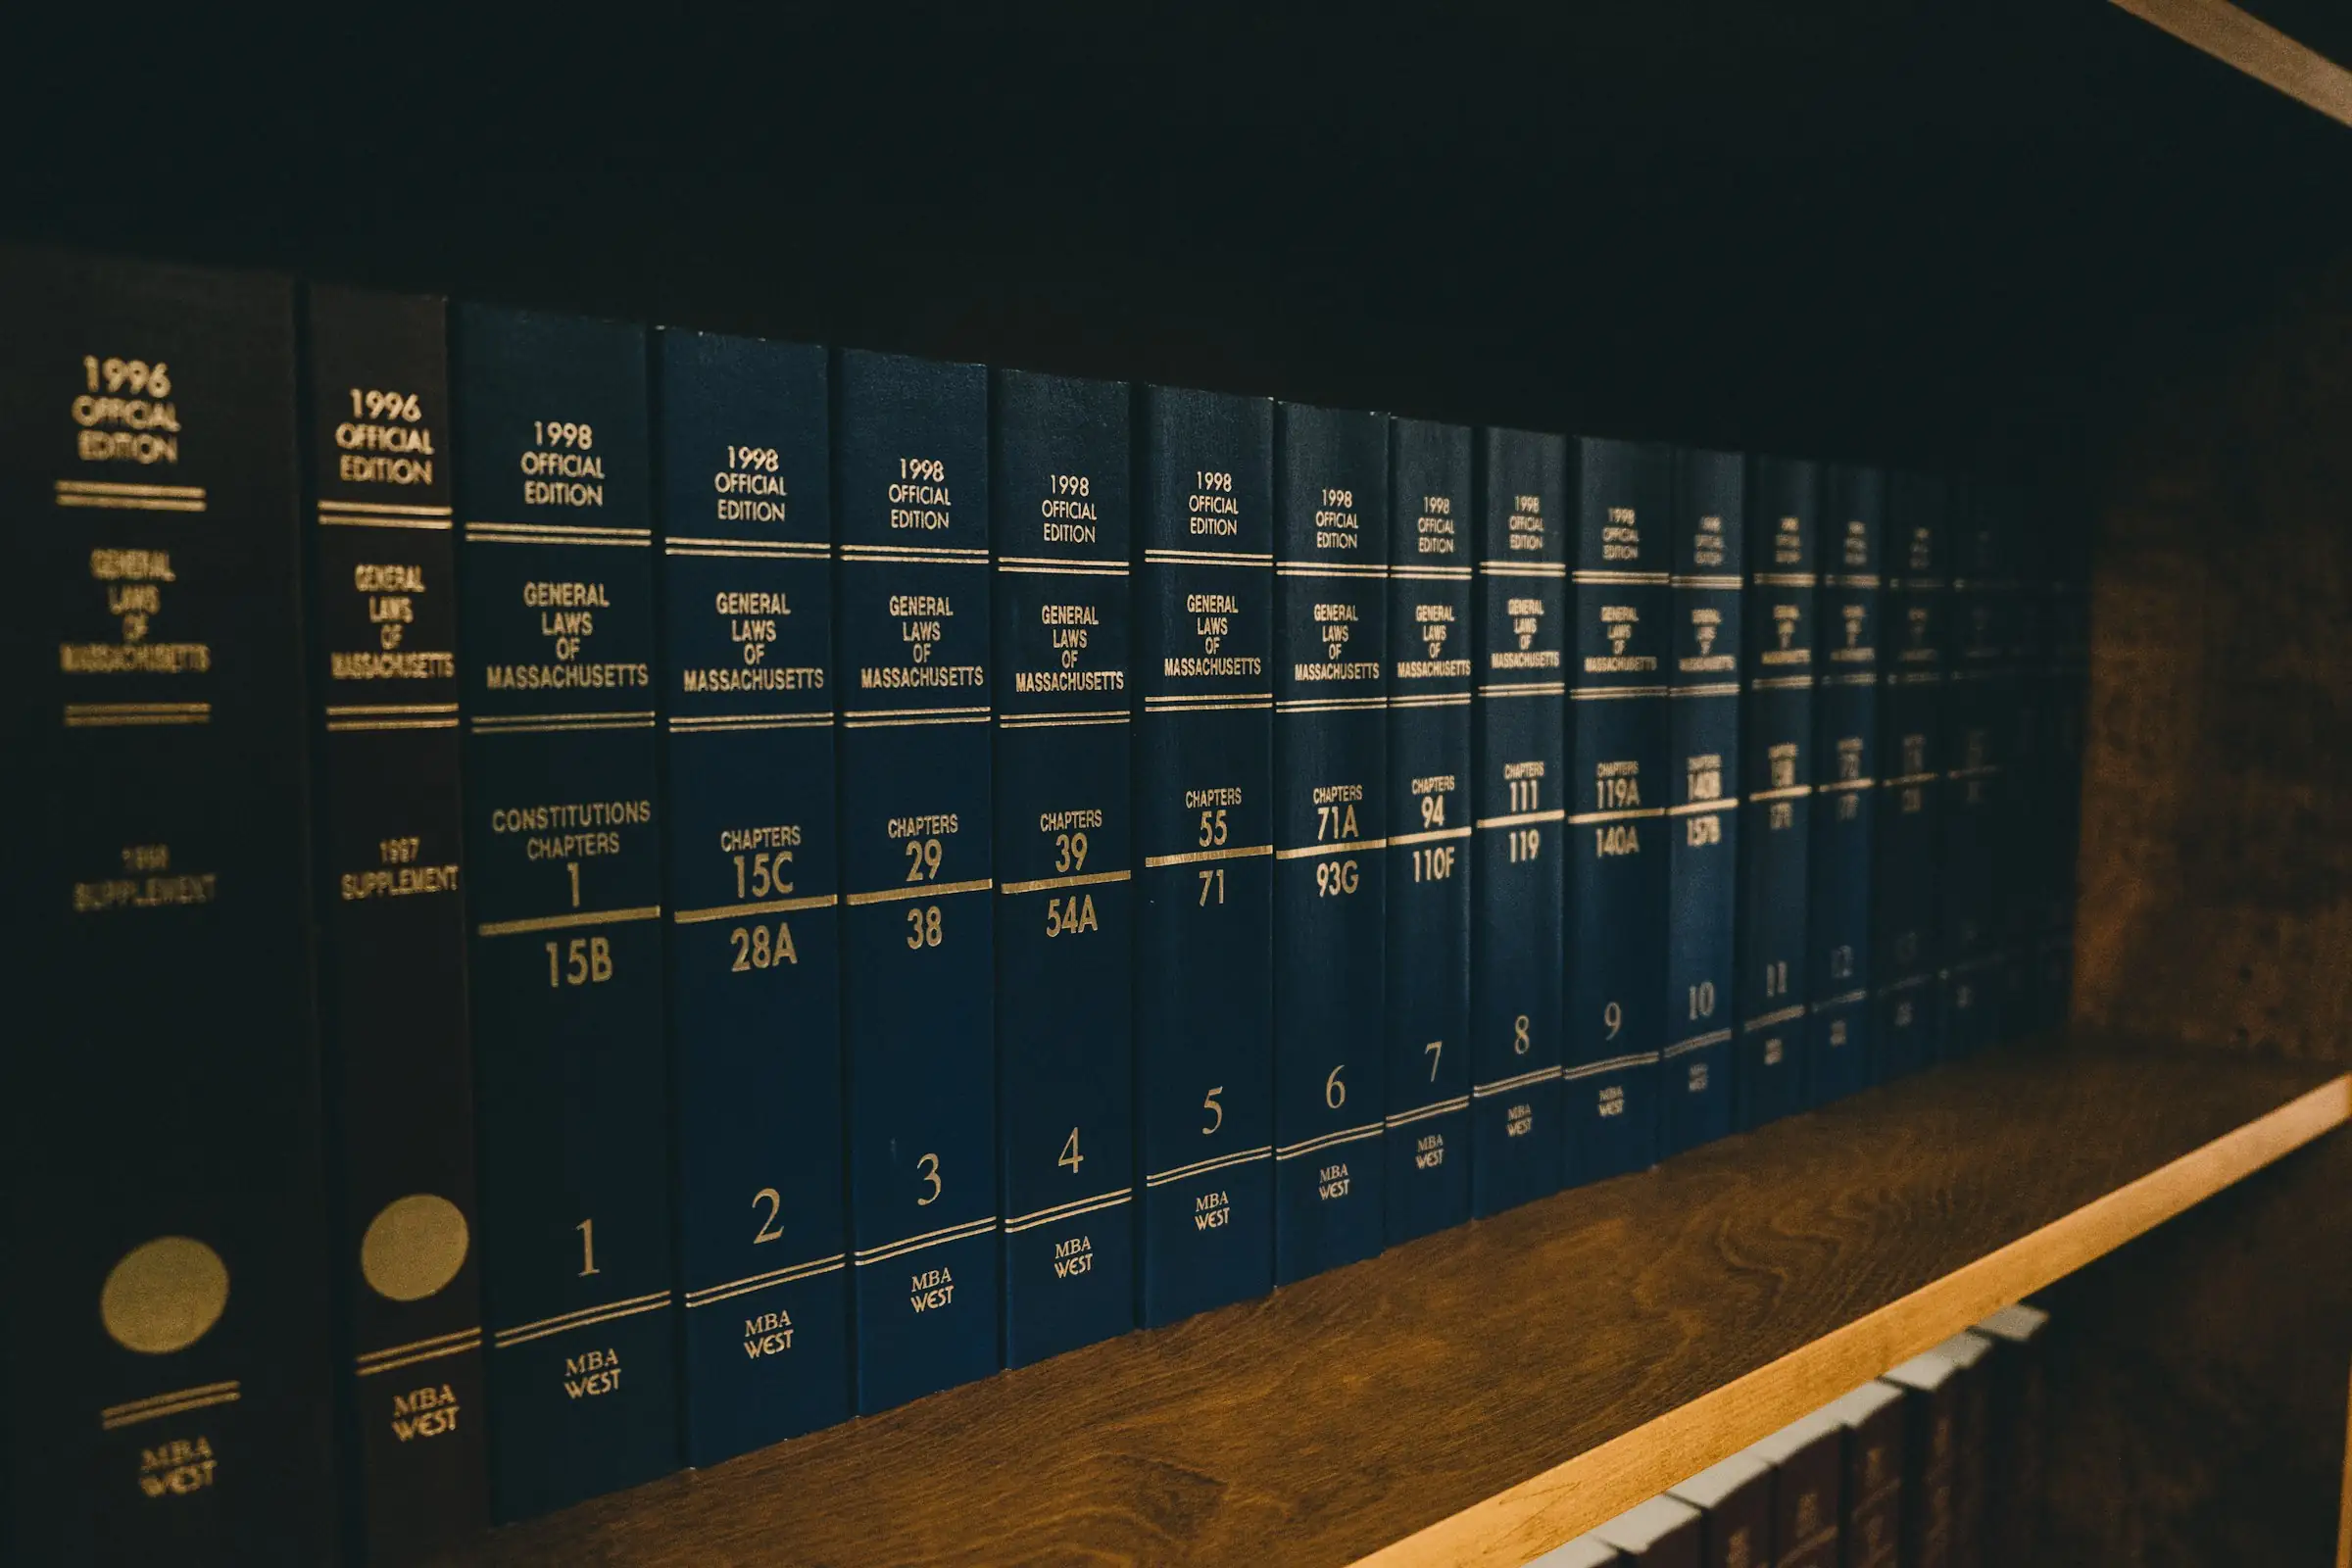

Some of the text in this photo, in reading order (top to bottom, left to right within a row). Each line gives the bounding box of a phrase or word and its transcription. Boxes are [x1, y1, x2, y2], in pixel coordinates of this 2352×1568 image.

[351, 389, 421, 422] 1996
[335, 423, 434, 455] OFFICIAL
[535, 421, 592, 450] 1998
[340, 455, 432, 484] EDITION
[520, 451, 605, 478] OFFICIAL
[728, 446, 779, 472] 1998
[901, 459, 944, 482] 1998
[714, 472, 787, 496] OFFICIAL
[1051, 474, 1089, 497] 1998
[1198, 471, 1232, 492] 1998
[524, 480, 603, 507] EDITION
[889, 484, 951, 506] OFFICIAL
[1189, 495, 1239, 514] OFFICIAL
[1322, 489, 1352, 508] 1998
[1515, 496, 1540, 514] 1998
[717, 499, 785, 521] EDITION
[1042, 500, 1097, 520] OFFICIAL
[1424, 497, 1449, 514] 1998
[891, 509, 949, 529] EDITION
[1191, 517, 1237, 535] EDITION
[1315, 511, 1358, 528] OFFICIAL
[1418, 517, 1454, 534] OFFICIAL
[1509, 515, 1544, 532] OFFICIAL
[1044, 523, 1095, 543] EDITION
[1317, 531, 1357, 549] EDITION
[1509, 533, 1543, 550] EDITION
[1418, 537, 1453, 554] EDITION
[355, 564, 425, 592] GENERAL
[523, 581, 610, 608] GENERAL
[716, 592, 791, 614] GENERAL
[890, 596, 954, 616] GENERAL
[1187, 594, 1239, 612] GENERAL
[369, 596, 413, 623] LAWS
[1042, 605, 1099, 625] GENERAL
[1314, 604, 1358, 621] GENERAL
[1415, 605, 1454, 622] GENERAL
[1508, 599, 1544, 615] GENERAL
[542, 612, 593, 635] LAWS
[732, 619, 776, 642] LAWS
[903, 621, 941, 641] LAWS
[1198, 617, 1228, 635] LAWS
[1323, 625, 1348, 642] LAWS
[1423, 625, 1446, 642] LAWS
[1514, 617, 1537, 634] LAWS
[381, 623, 403, 650] OF
[1054, 629, 1087, 648] LAWS
[1205, 637, 1220, 655] OF
[1519, 634, 1531, 650] OF
[556, 636, 580, 661] OF
[744, 643, 764, 665] OF
[913, 643, 931, 663] OF
[1062, 650, 1078, 668] OF
[1329, 643, 1342, 660] OF
[1429, 642, 1441, 659] OF
[1491, 651, 1560, 668] MASSACHUSETTS
[331, 652, 454, 679] MASSACHUSETTS
[487, 663, 649, 690] MASSACHUSETTS
[861, 665, 983, 688] MASSACHUSETTS
[1164, 658, 1261, 676] MASSACHUSETTS
[1295, 662, 1379, 681] MASSACHUSETTS
[1397, 660, 1471, 678] MASSACHUSETTS
[684, 668, 823, 692] MASSACHUSETTS
[1016, 671, 1123, 692] MASSACHUSETTS
[1504, 761, 1544, 781] CHAPTERS
[1313, 784, 1362, 805] CHAPTERS
[1411, 775, 1454, 795] CHAPTERS
[1509, 780, 1539, 812] 111
[1596, 778, 1640, 809] 119A
[1186, 787, 1242, 808] CHAPTERS
[493, 800, 651, 832] CONSTITUTIONS
[1040, 809, 1102, 832] CHAPTERS
[1317, 805, 1358, 841] 71A
[1421, 795, 1445, 828] 94
[888, 813, 957, 838] CHAPTERS
[1200, 809, 1227, 847] 55
[527, 832, 619, 860] CHAPTERS
[721, 825, 801, 852] CHAPTERS
[1509, 829, 1540, 862] 119
[1595, 825, 1639, 858] 140A
[906, 839, 942, 881] 29
[1055, 832, 1087, 872] 39
[734, 851, 793, 898] 15C
[1413, 847, 1454, 882] 110F
[342, 864, 459, 900] SUPPLEMENT
[567, 862, 580, 907] 1
[1200, 869, 1224, 906] 71
[1316, 860, 1358, 898] 93G
[1047, 895, 1098, 937] 54A
[907, 906, 942, 950] 38
[730, 922, 798, 972] 28A
[546, 937, 612, 988] 15B
[1690, 982, 1715, 1020] 10
[1604, 1003, 1621, 1040] 9
[1515, 1015, 1529, 1054] 8
[1425, 1041, 1443, 1082] 7
[1326, 1065, 1346, 1108] 6
[1202, 1086, 1223, 1134] 5
[1508, 1104, 1531, 1123] MBA
[1506, 1117, 1532, 1137] WEST
[1058, 1127, 1084, 1173] 4
[1418, 1135, 1443, 1152] MBA
[1415, 1149, 1444, 1168] WEST
[917, 1153, 941, 1205] 3
[1320, 1163, 1348, 1186] MBA
[1319, 1179, 1349, 1200] WEST
[1196, 1191, 1230, 1215] MBA
[753, 1188, 784, 1244] 2
[1195, 1207, 1230, 1230] WEST
[576, 1219, 600, 1276] 1
[1055, 1236, 1091, 1259] MBA
[1054, 1253, 1093, 1278] WEST
[911, 1267, 952, 1293] MBA
[910, 1285, 954, 1312] WEST
[745, 1310, 792, 1337] MBA
[744, 1329, 794, 1359] WEST
[565, 1348, 618, 1376] MBA
[564, 1368, 621, 1398] WEST
[394, 1384, 456, 1418] MBA
[392, 1405, 460, 1442] WEST
